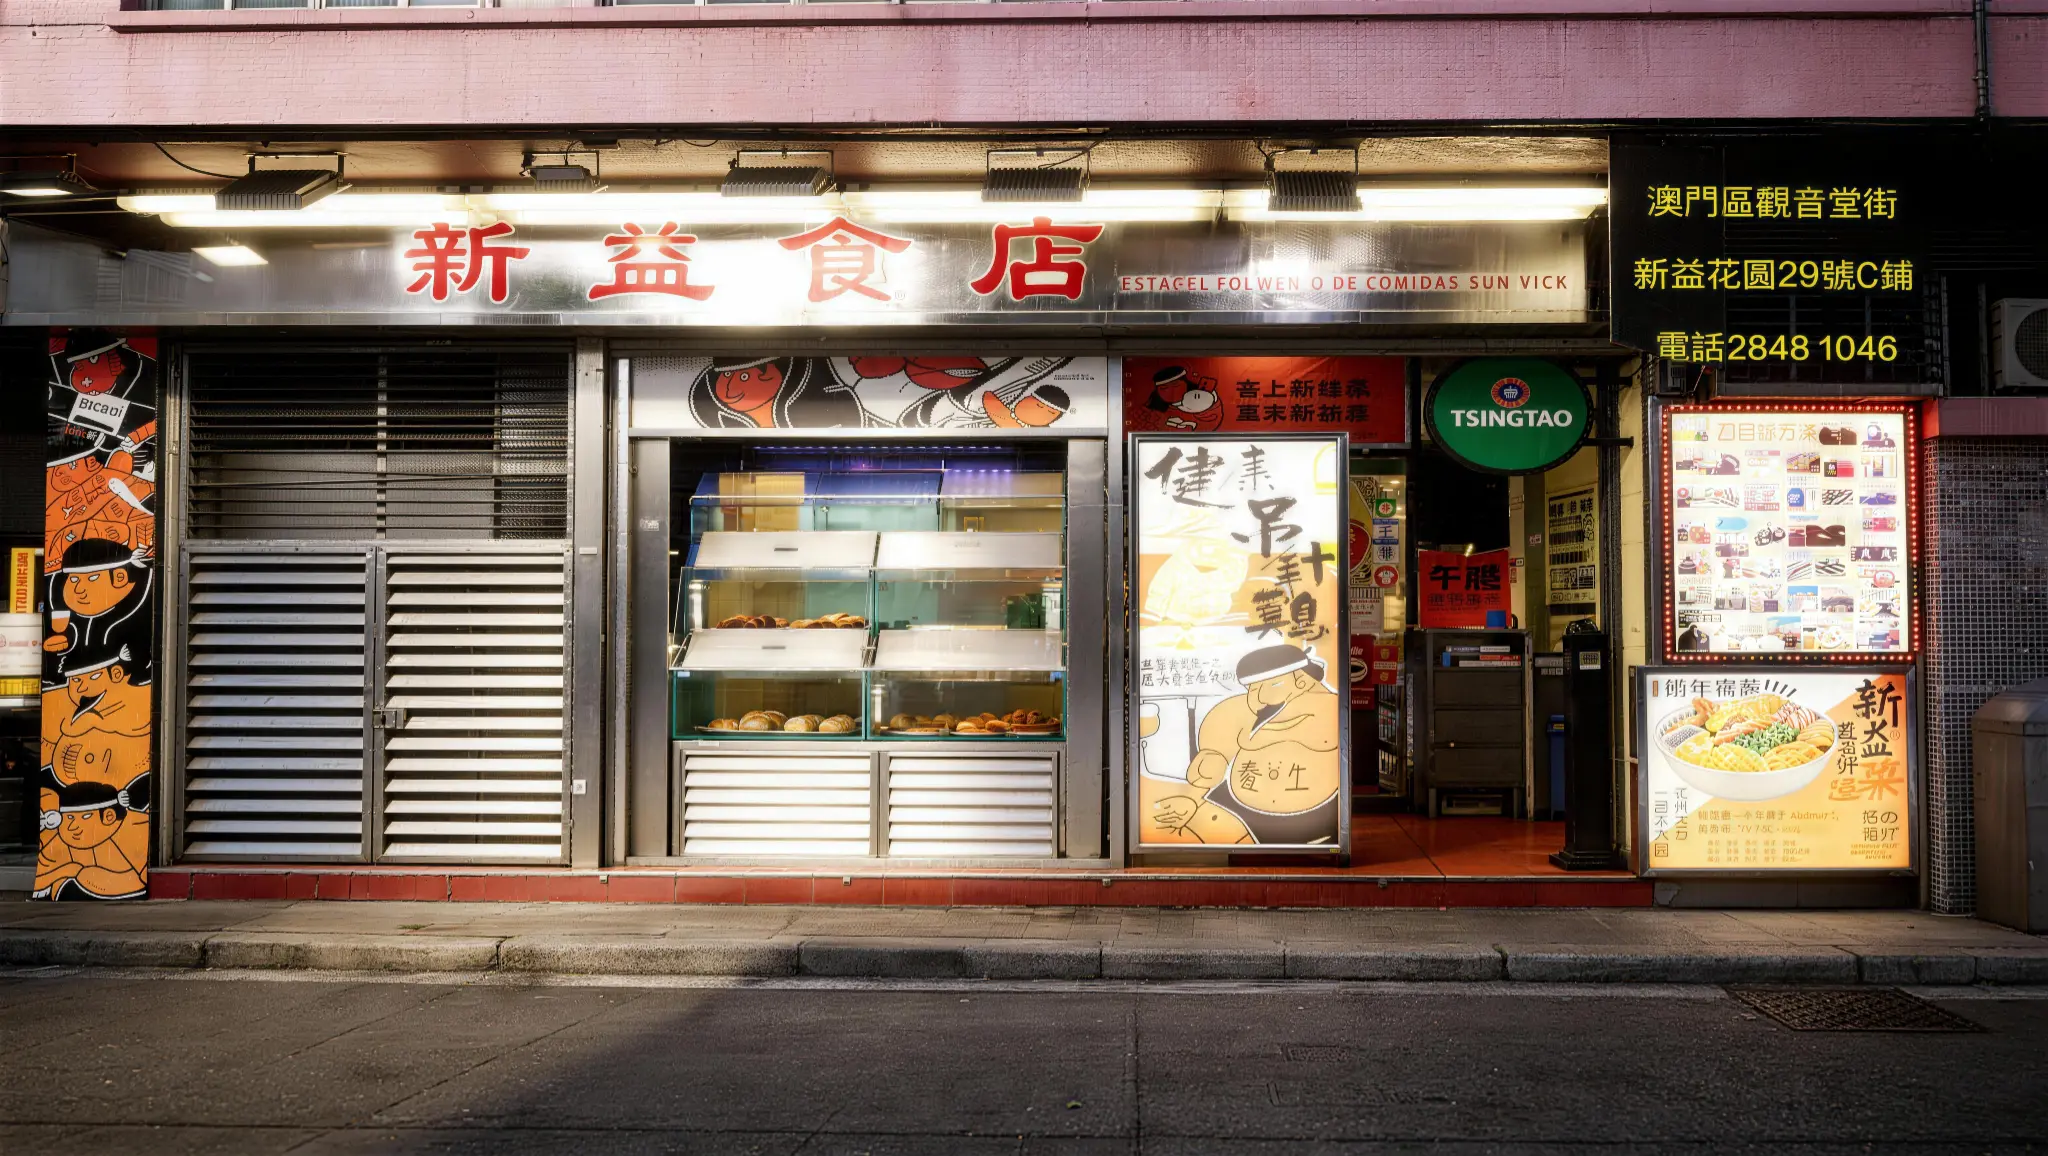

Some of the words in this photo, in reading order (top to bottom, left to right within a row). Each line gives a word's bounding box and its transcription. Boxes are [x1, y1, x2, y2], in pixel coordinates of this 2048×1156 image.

[1647, 184, 1897, 220] 澳門區觀音堂街
[405, 217, 1103, 302] 新益食店
[1333, 275, 1357, 291] DE
[1366, 275, 1459, 291] COMIDAS
[1470, 275, 1509, 290] SUN
[1519, 275, 1568, 290] VICK
[1656, 331, 1810, 363] 電話2848
[1824, 334, 1898, 362] 1046
[1450, 410, 1573, 427] TSINGTAO
